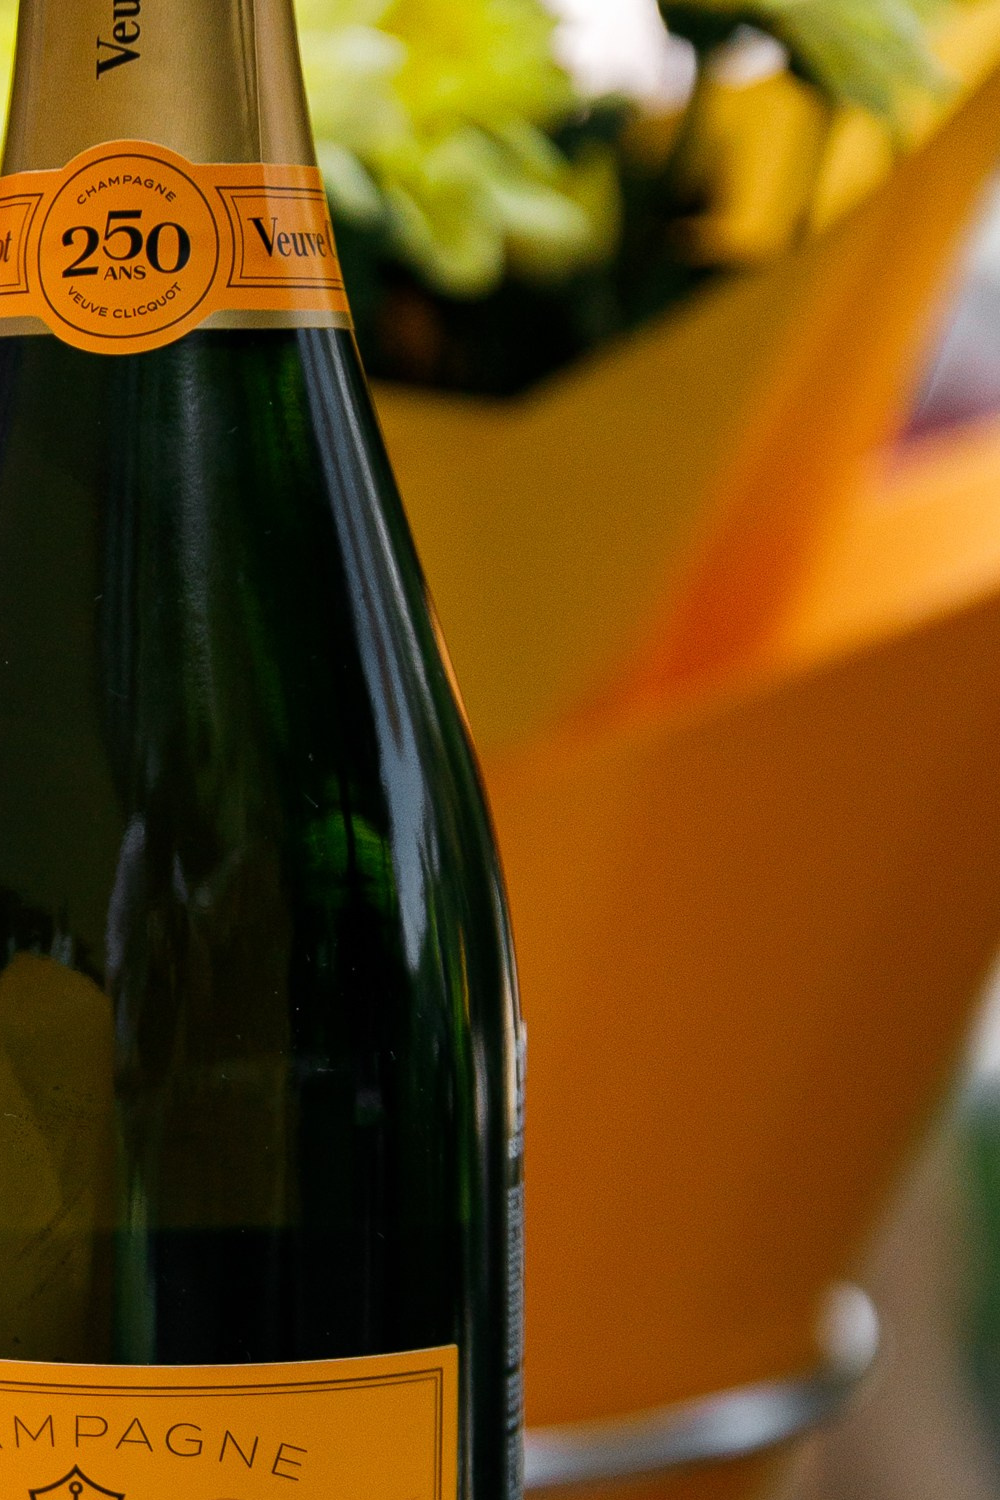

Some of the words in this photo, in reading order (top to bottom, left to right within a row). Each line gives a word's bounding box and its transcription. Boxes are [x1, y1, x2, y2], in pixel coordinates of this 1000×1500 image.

[96, 0, 141, 80] Veu
[76, 174, 176, 205] CHAMPAGNE
[61, 209, 191, 279] 250
[247, 216, 327, 258] Veuve
[103, 264, 147, 281] ANS
[67, 285, 108, 318] VEUVE
[112, 281, 182, 320] CLICQUOT
